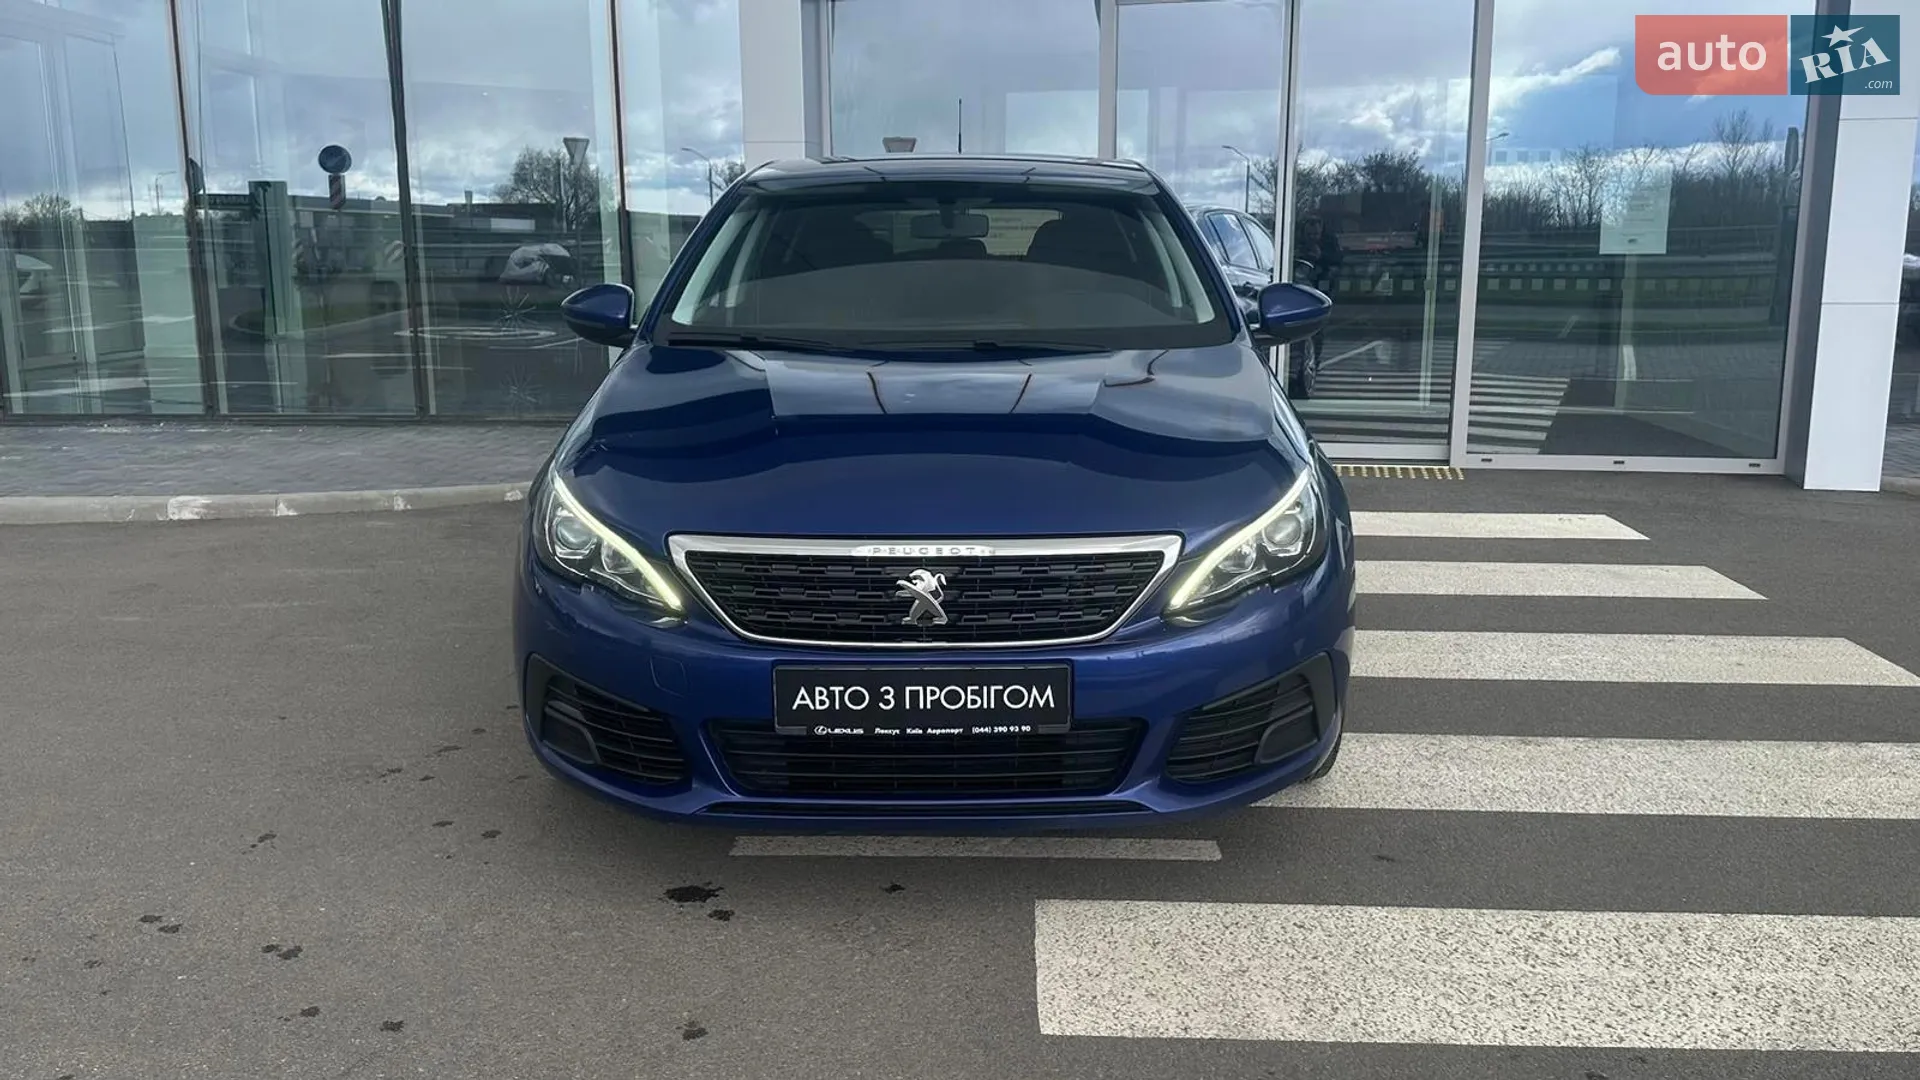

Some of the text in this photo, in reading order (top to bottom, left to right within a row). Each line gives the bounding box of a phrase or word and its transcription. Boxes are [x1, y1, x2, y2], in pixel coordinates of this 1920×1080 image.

[872, 547, 976, 555] PEUGEOT
[792, 686, 869, 710] АВТО
[904, 685, 1055, 710] ПРОБІГОМ
[927, 727, 963, 735] Аеропорт
[972, 726, 992, 735] (044)
[993, 725, 1008, 734] 390
[1009, 725, 1020, 733] 93
[1021, 724, 1032, 733] 90
